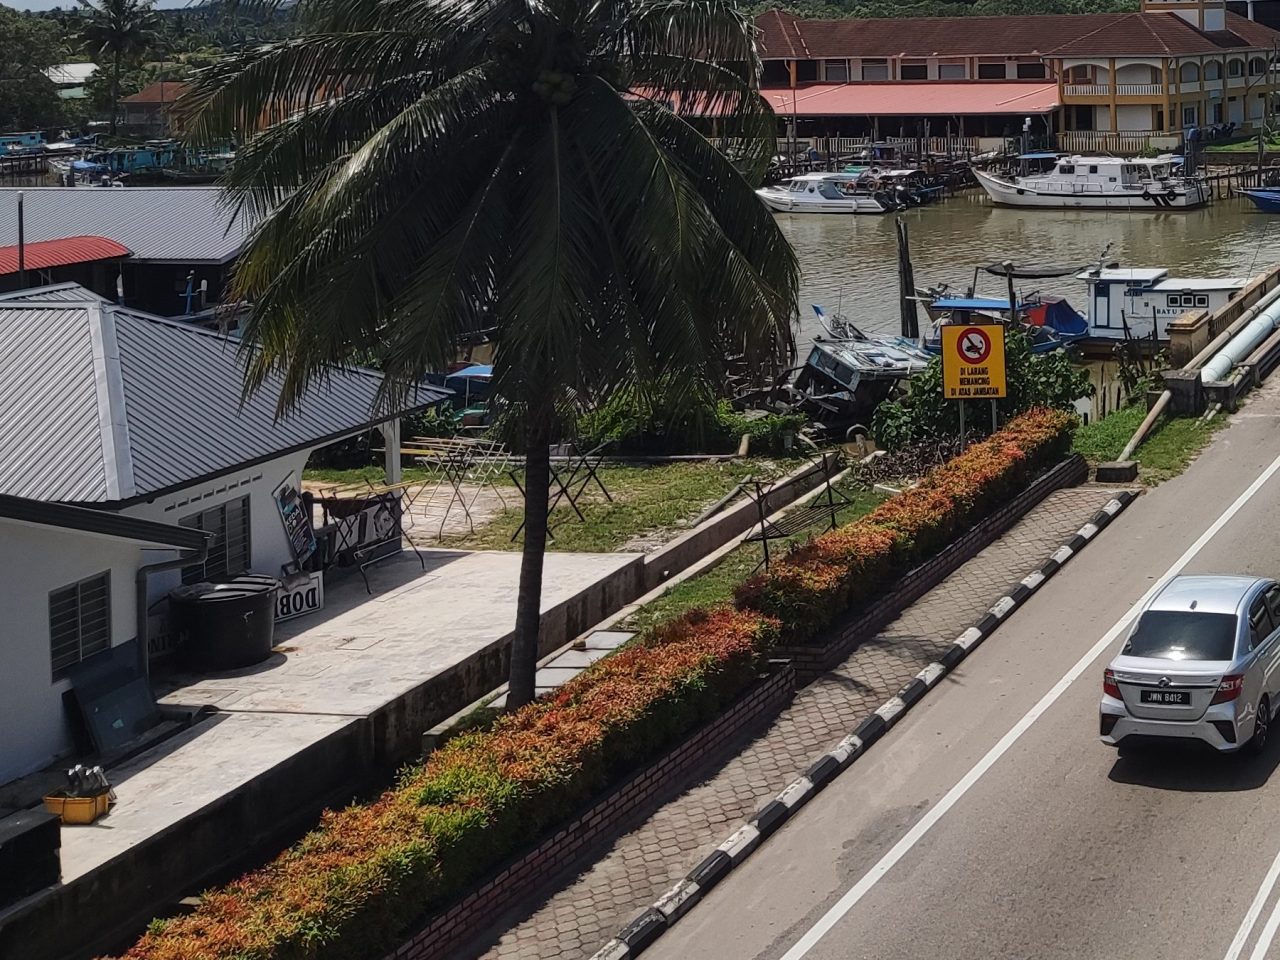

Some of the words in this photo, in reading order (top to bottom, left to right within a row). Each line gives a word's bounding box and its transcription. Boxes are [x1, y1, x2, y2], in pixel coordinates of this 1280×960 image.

[960, 367, 965, 376] DI
[967, 367, 989, 376] LARANG
[960, 377, 991, 386] MEMANCING
[951, 388, 957, 396] DI
[958, 387, 971, 396] ATAS
[973, 387, 999, 396] JAMBATAN
[1147, 692, 1162, 702] JWN
[1164, 693, 1182, 703] 8412
